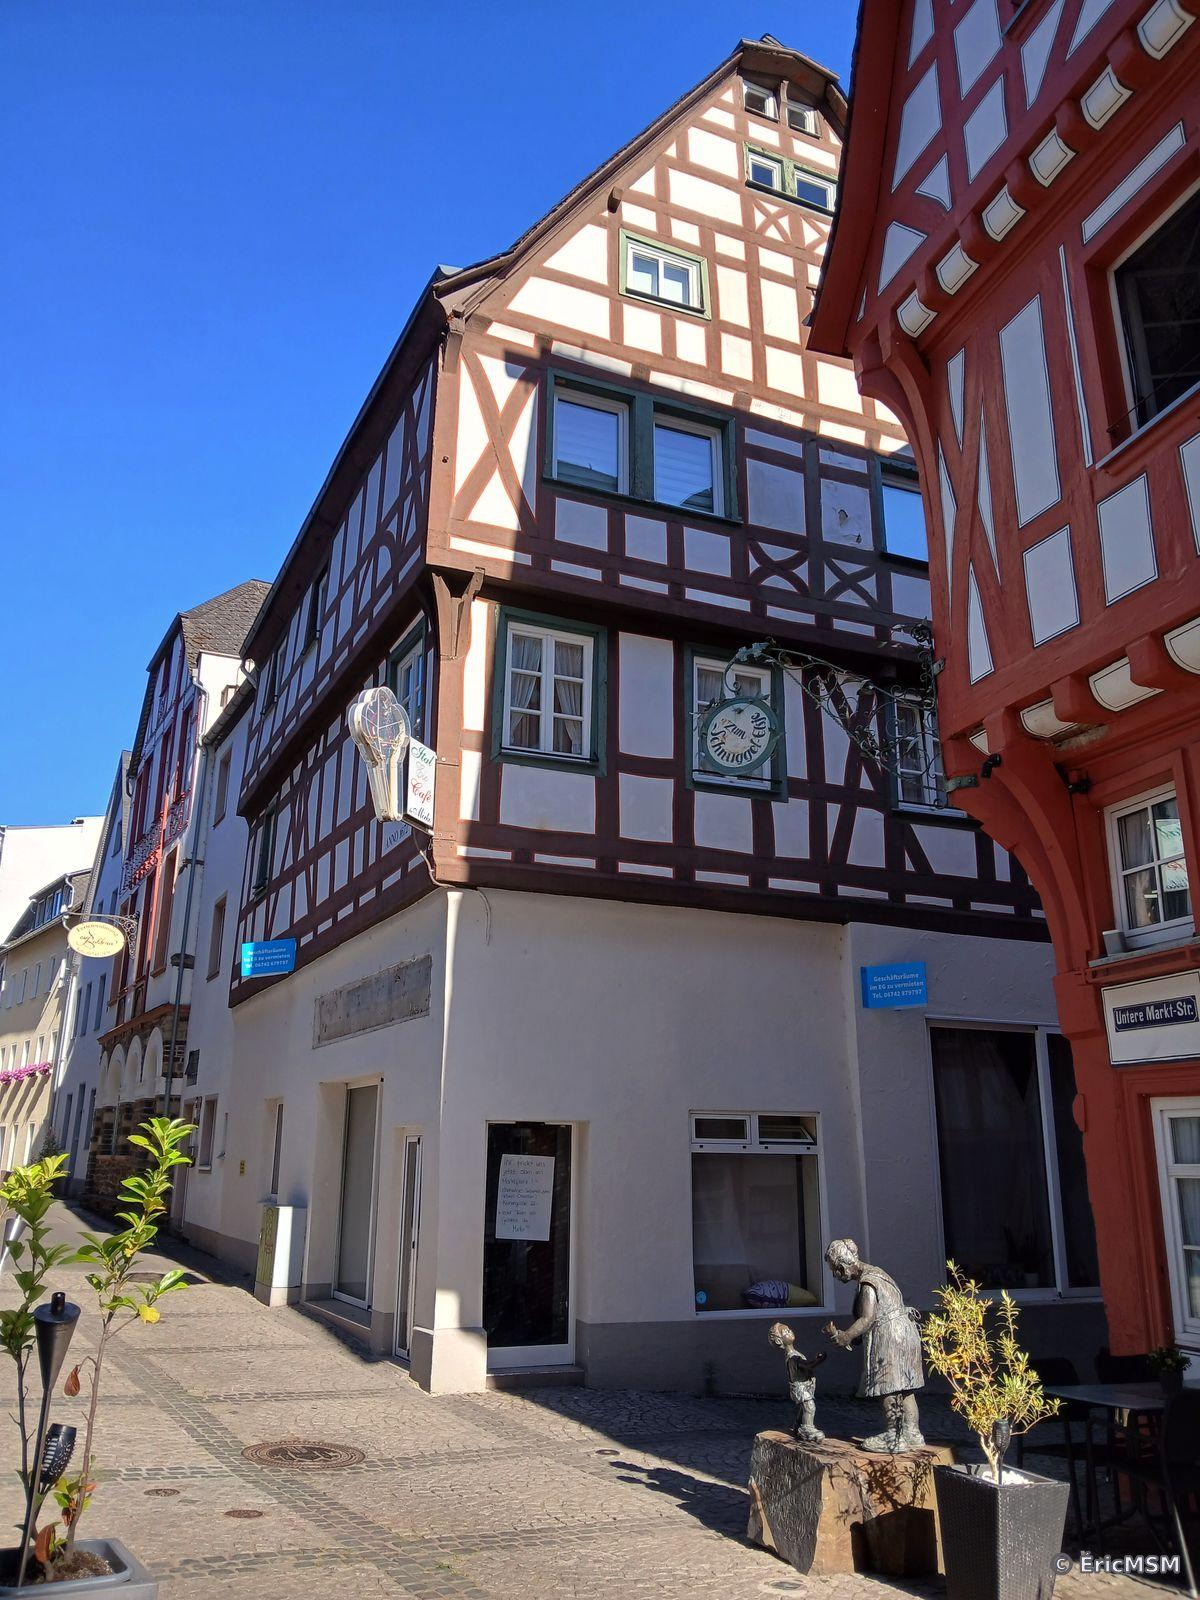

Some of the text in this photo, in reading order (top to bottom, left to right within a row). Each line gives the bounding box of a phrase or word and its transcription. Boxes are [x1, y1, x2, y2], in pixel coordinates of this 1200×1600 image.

[724, 720, 747, 740] Zum
[411, 746, 435, 767] Ital
[410, 778, 432, 804] Café
[873, 973, 920, 982] Geschäftsräume
[894, 980, 925, 989] vermieten
[1116, 1001, 1195, 1025] Untere Markt-Str.
